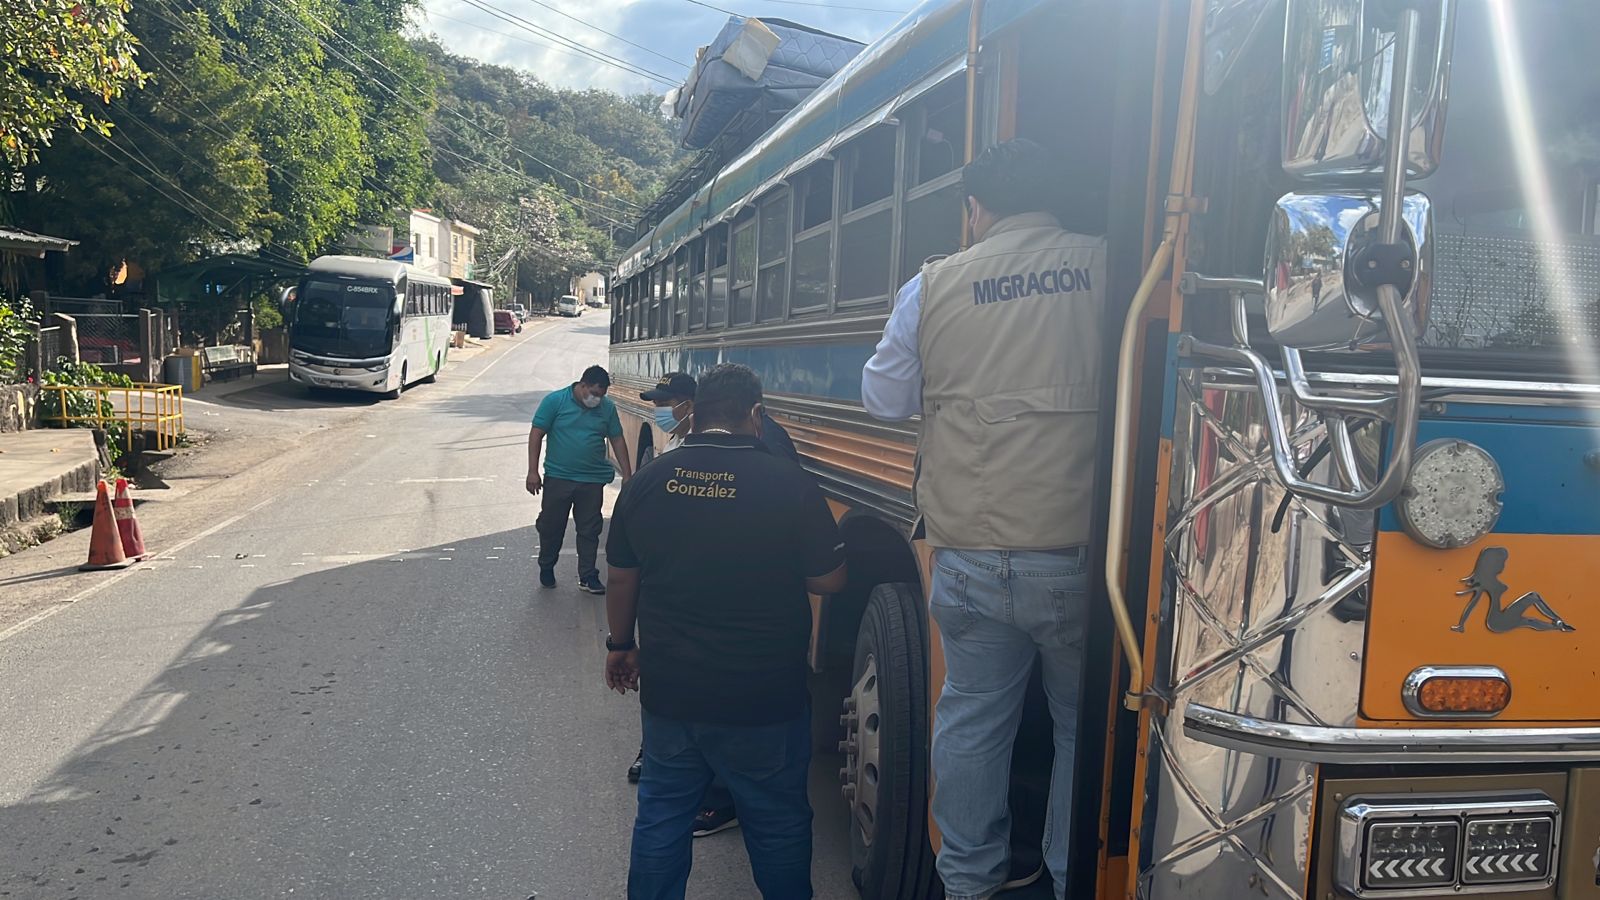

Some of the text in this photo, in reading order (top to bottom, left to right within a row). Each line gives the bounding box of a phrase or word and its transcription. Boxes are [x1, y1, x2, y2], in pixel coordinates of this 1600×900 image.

[973, 261, 1091, 305] MIGRACIÓN
[674, 467, 735, 482] Transporte
[666, 479, 737, 498] González
